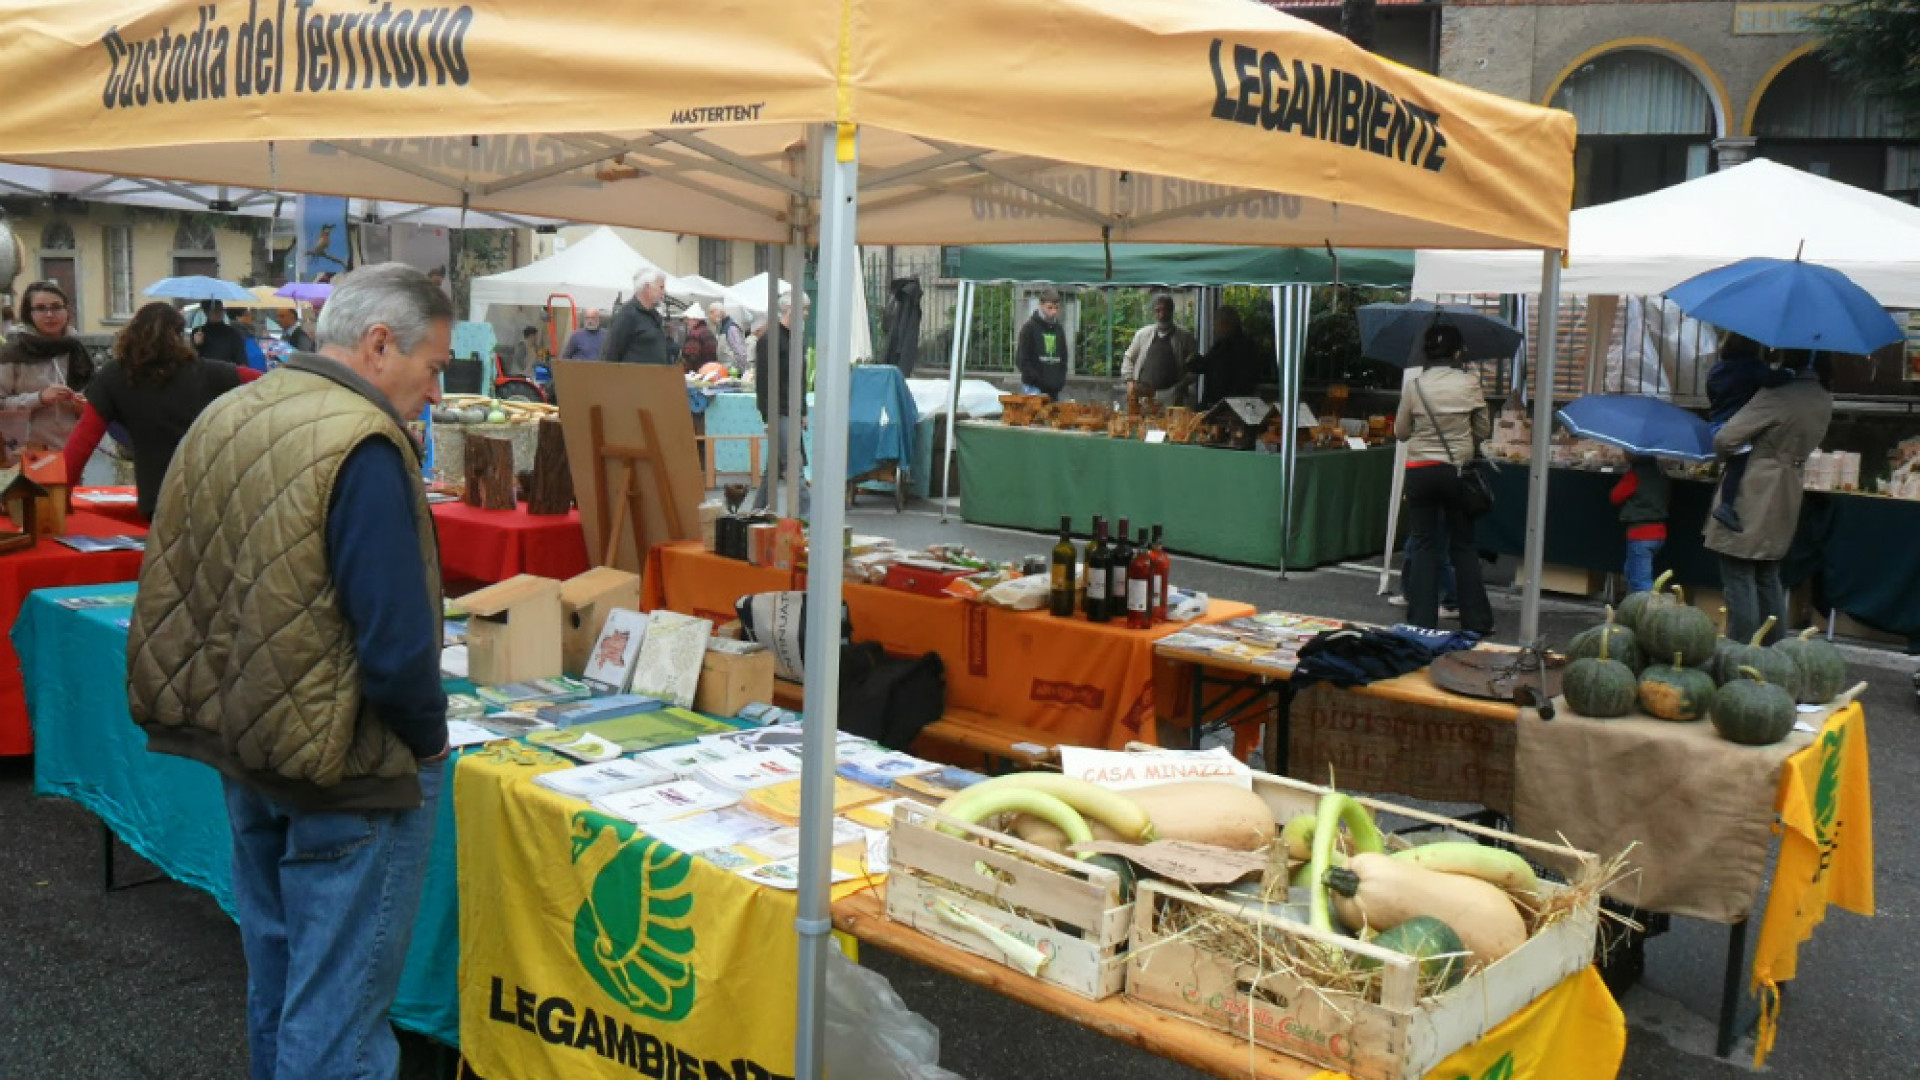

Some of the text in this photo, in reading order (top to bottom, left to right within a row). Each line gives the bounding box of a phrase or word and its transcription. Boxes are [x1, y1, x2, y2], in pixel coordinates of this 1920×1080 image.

[102, 0, 473, 109] Custodia del Territorio
[1209, 38, 1447, 172] LEGAMBIENTE
[670, 103, 762, 124] MASTERTENT
[1083, 764, 1236, 783] CASA MINAZZI
[489, 976, 795, 1080] LEGAMBIE
